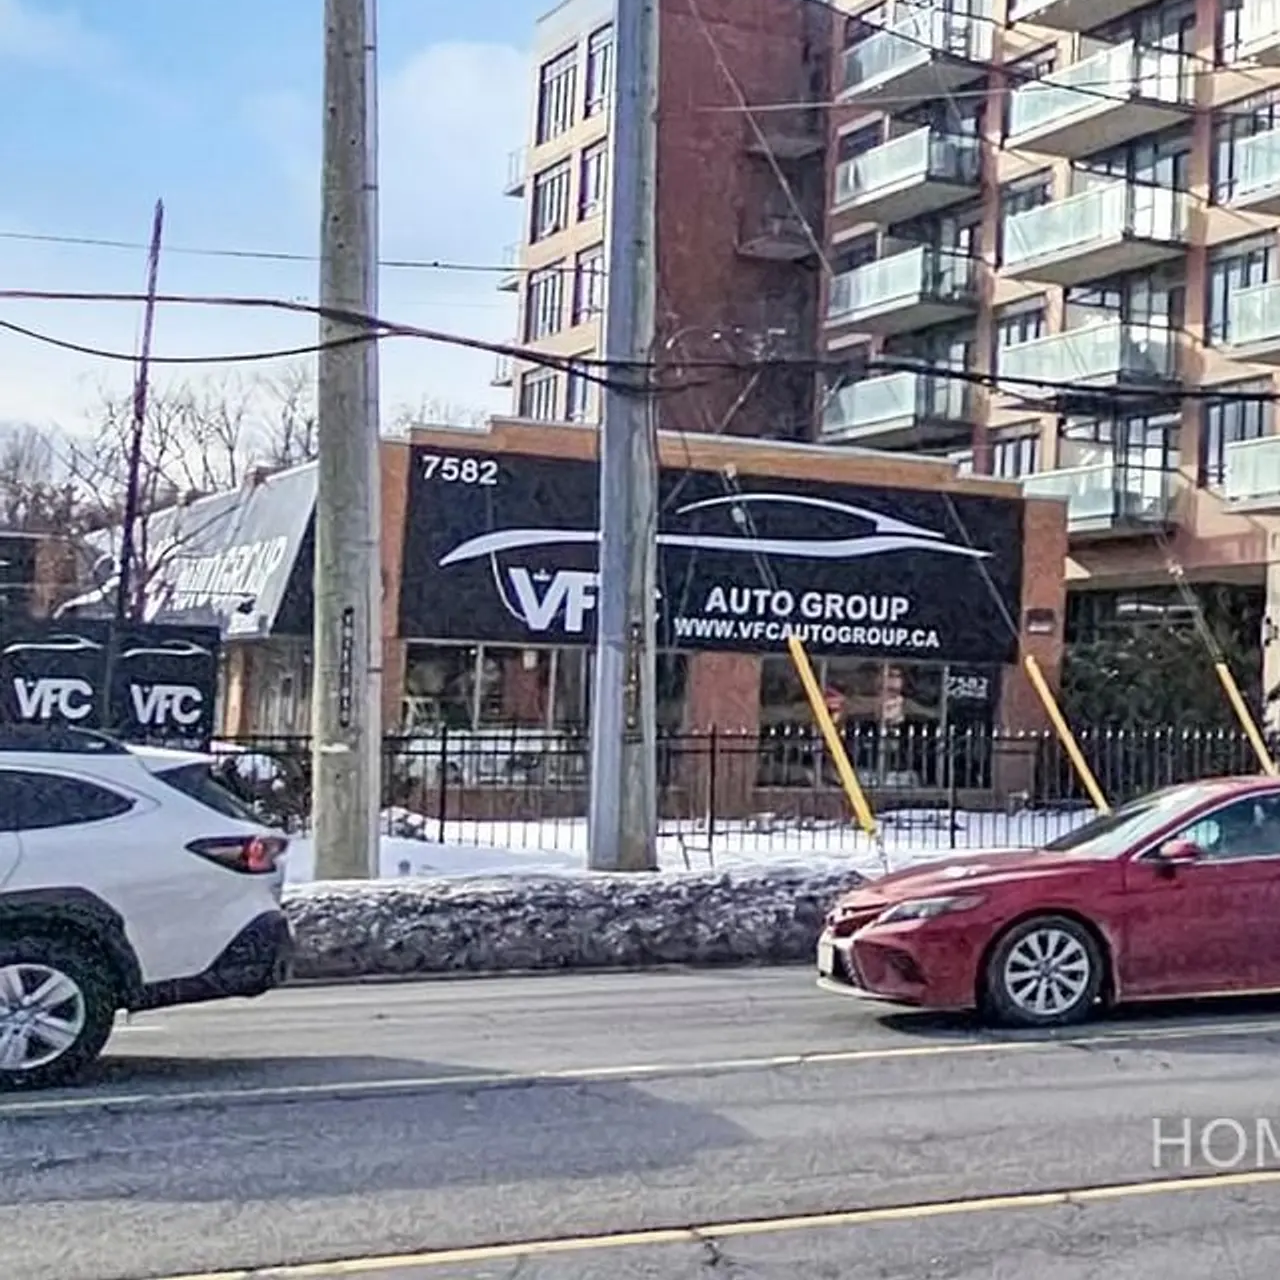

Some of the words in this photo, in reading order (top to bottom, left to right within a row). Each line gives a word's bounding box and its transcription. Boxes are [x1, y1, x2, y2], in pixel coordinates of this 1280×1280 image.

[422, 454, 499, 486] 7582
[705, 586, 795, 616] AUTO
[801, 592, 909, 621] GROUP
[673, 617, 940, 649] WWW.VFCAUTOGROUP.CA
[13, 677, 94, 720] VFC
[130, 683, 204, 725] VFC
